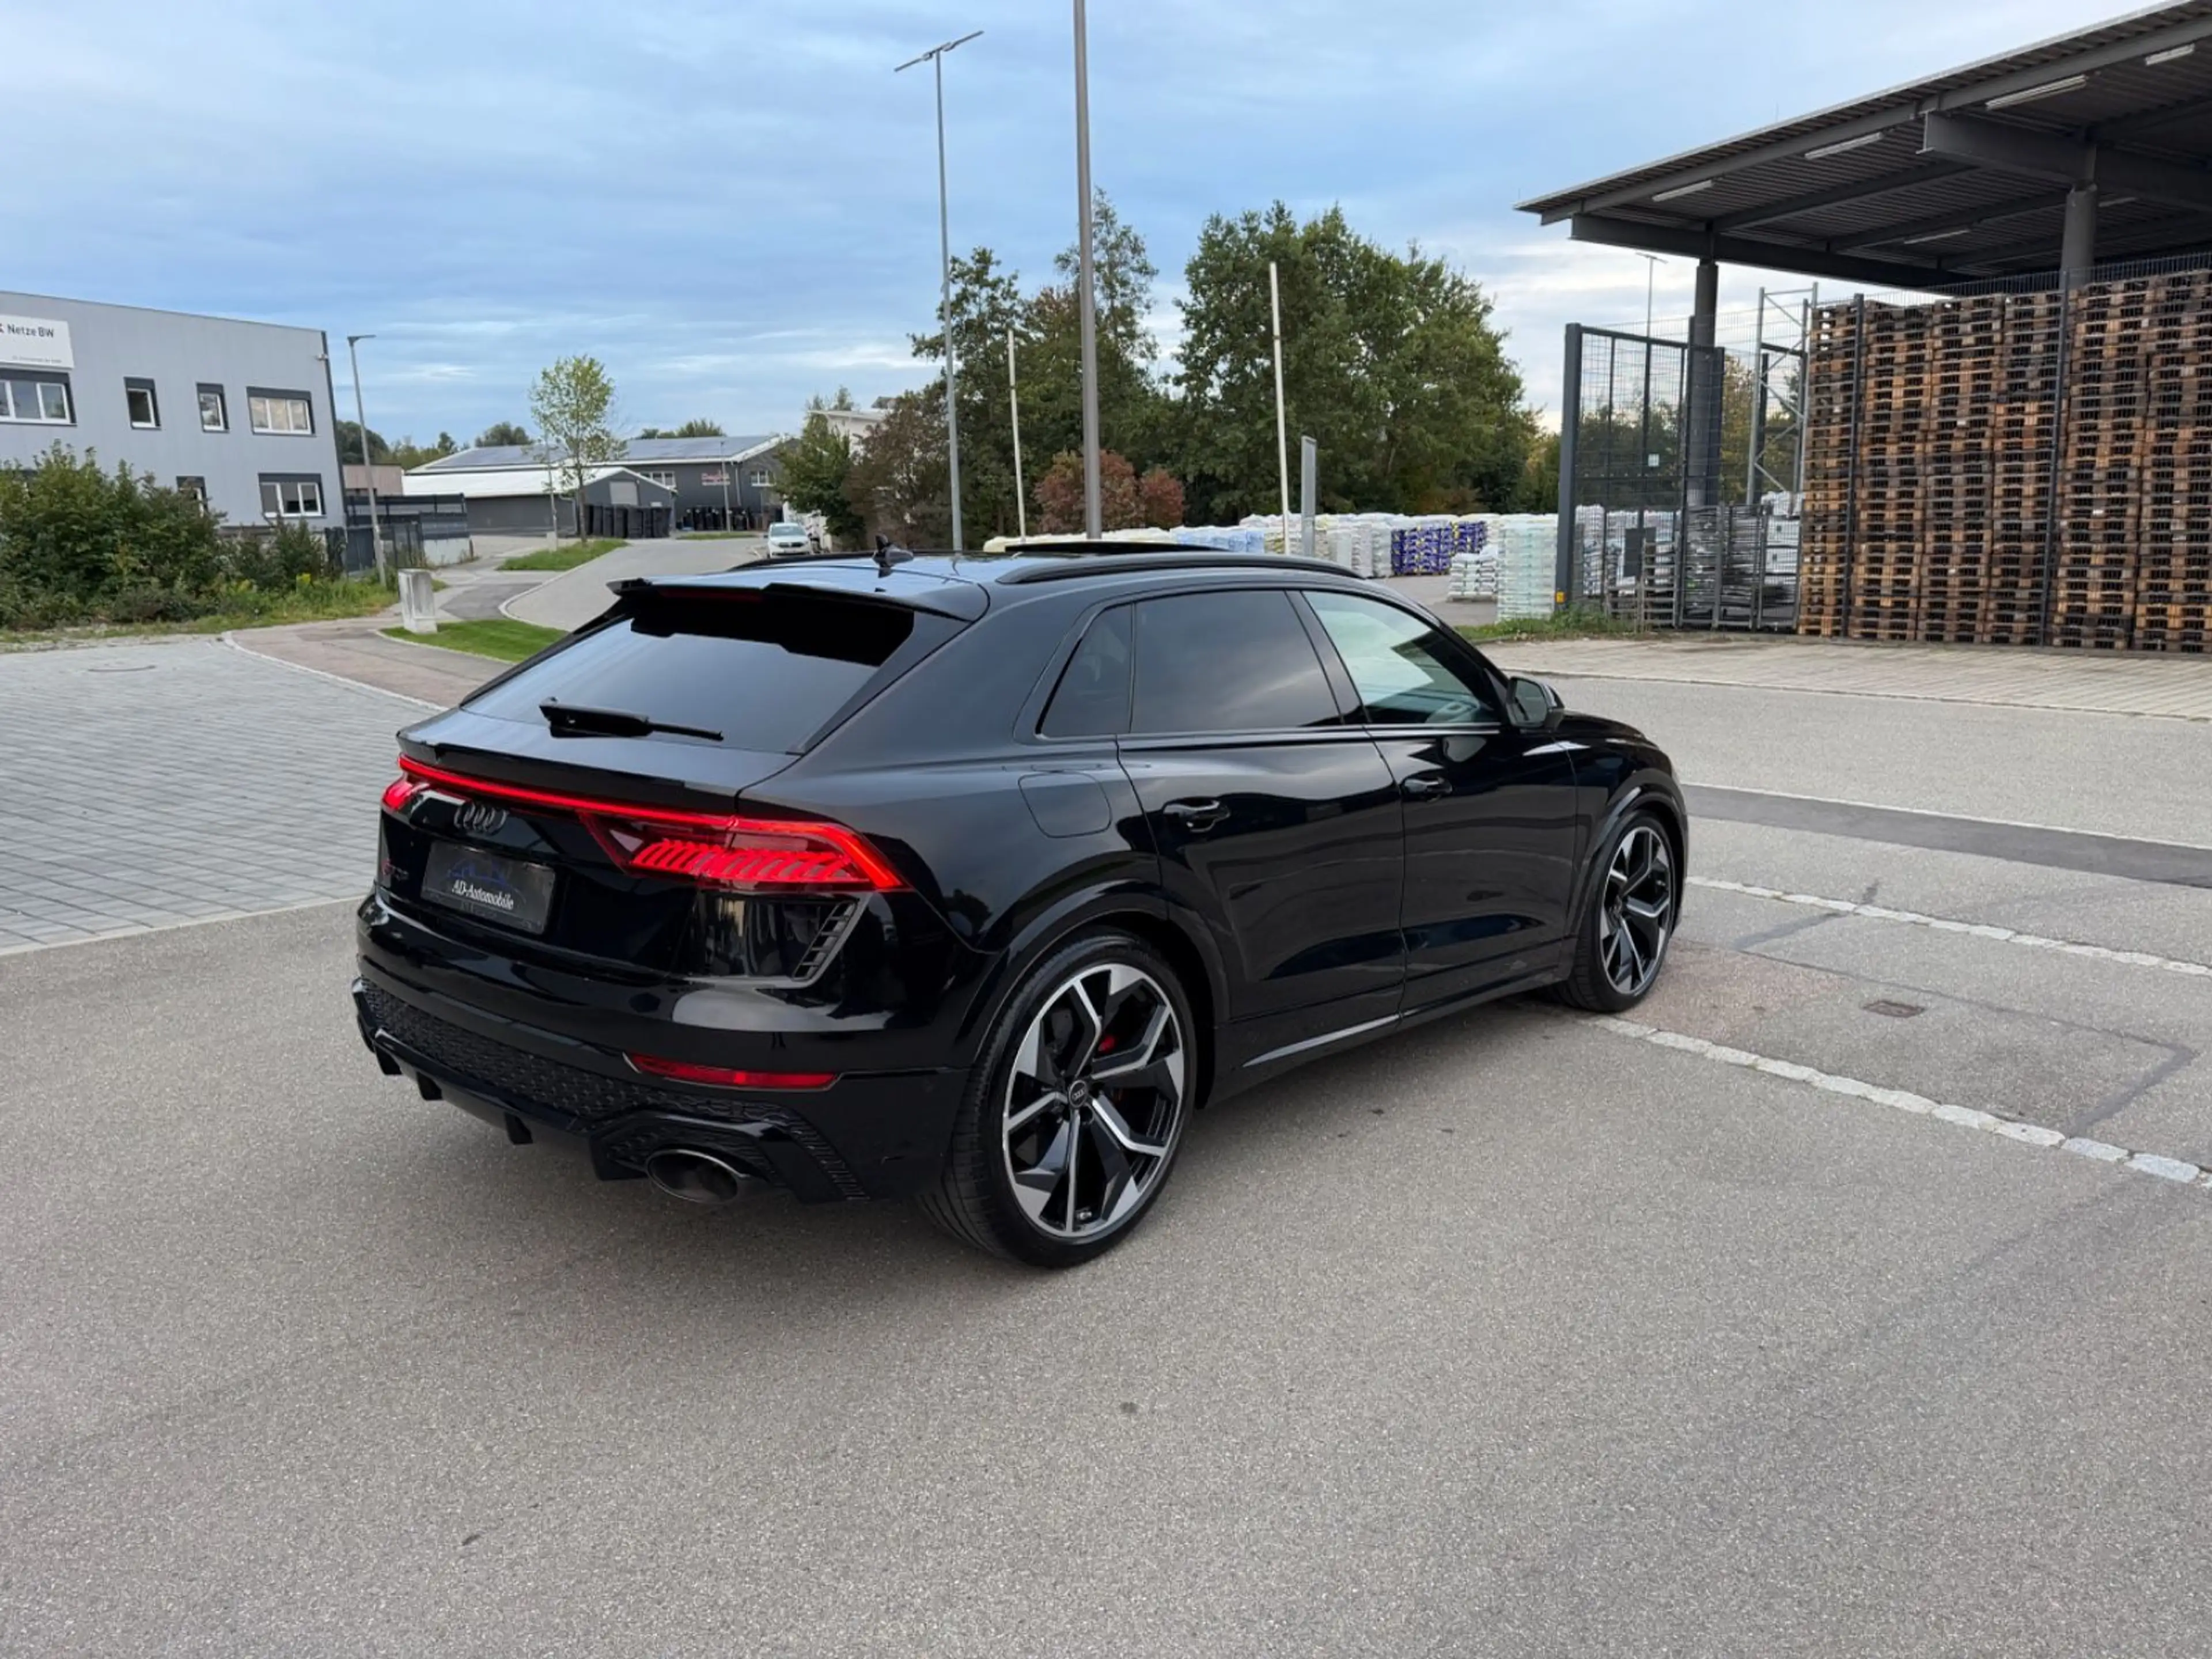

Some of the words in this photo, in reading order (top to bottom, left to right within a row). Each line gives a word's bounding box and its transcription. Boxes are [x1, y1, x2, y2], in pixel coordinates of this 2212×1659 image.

[7, 323, 37, 337] Netze
[38, 326, 55, 339] BW
[451, 878, 514, 911] AD-Automobile
